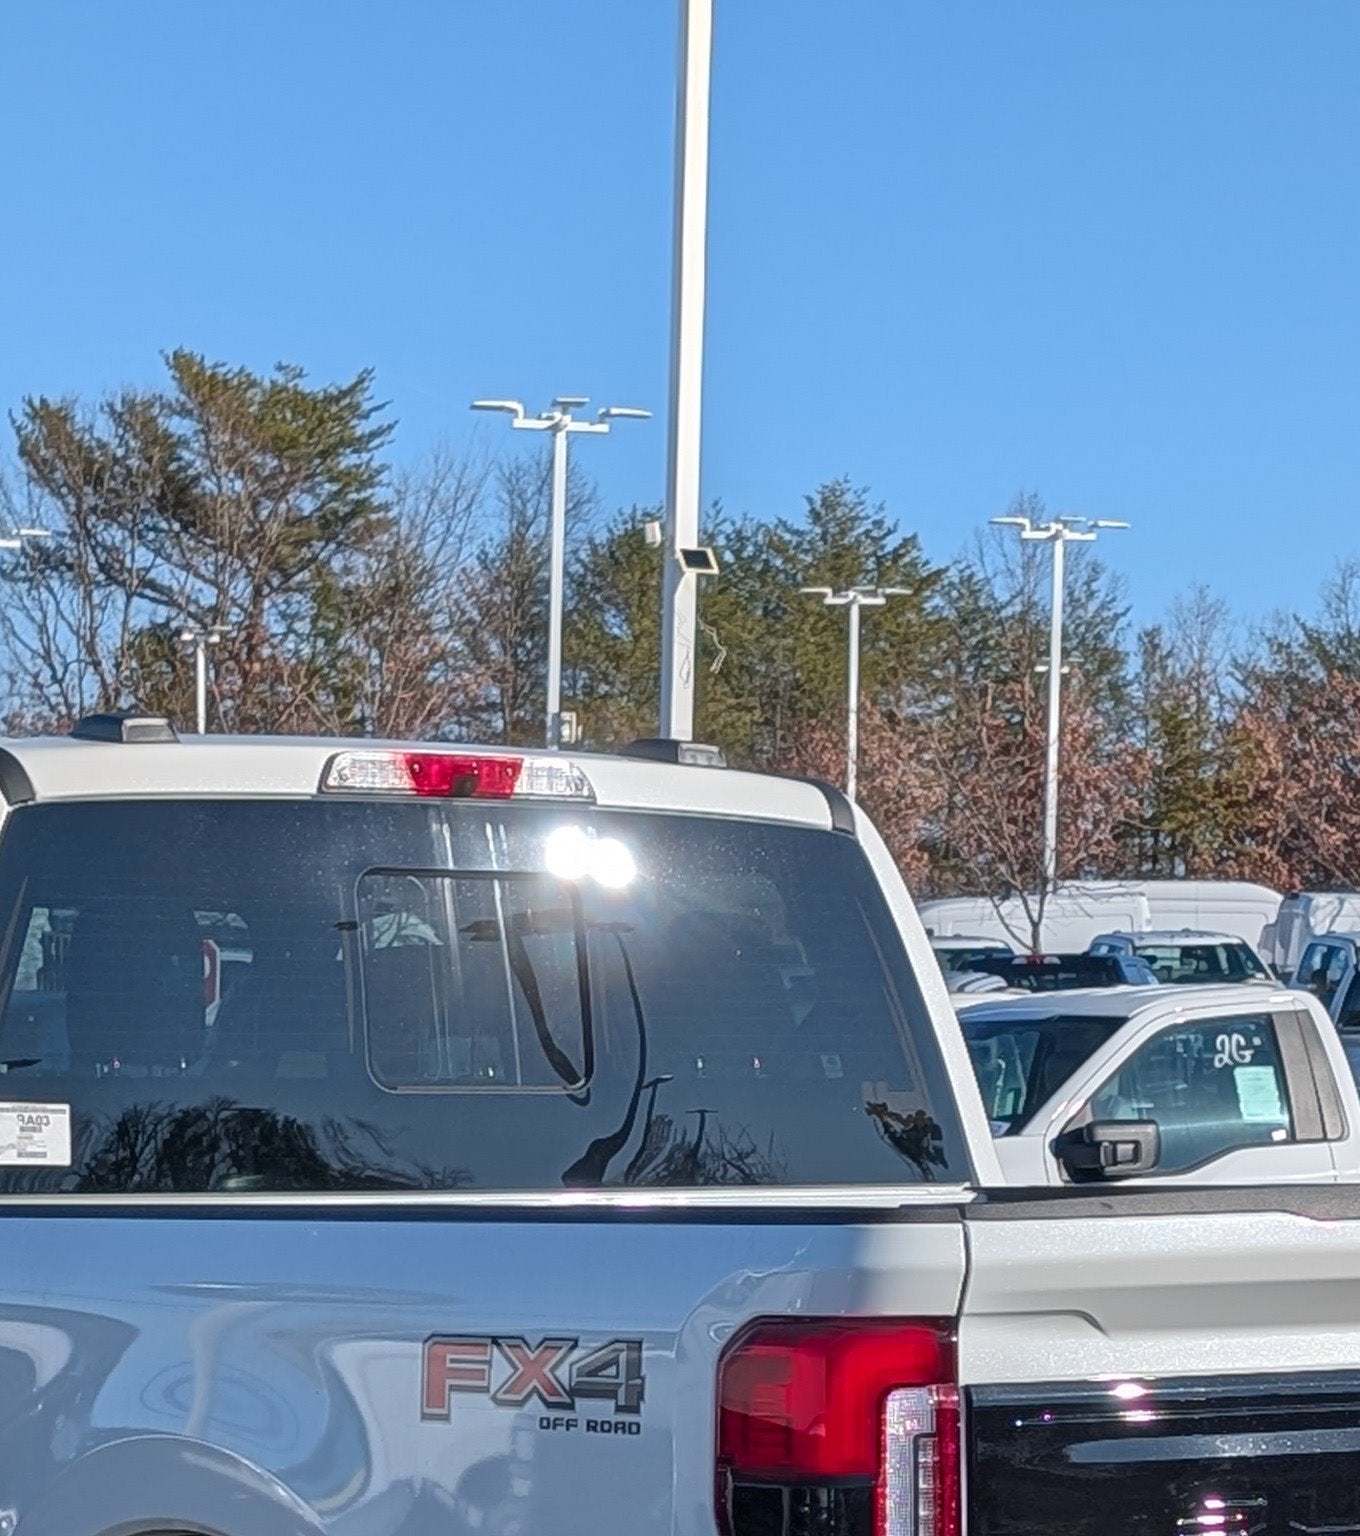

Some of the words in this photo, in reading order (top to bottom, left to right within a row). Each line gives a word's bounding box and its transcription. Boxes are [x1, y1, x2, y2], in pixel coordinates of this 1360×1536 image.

[421, 1332, 645, 1422] FX4
[539, 1416, 578, 1433] OFF
[586, 1419, 641, 1436] ROAD
